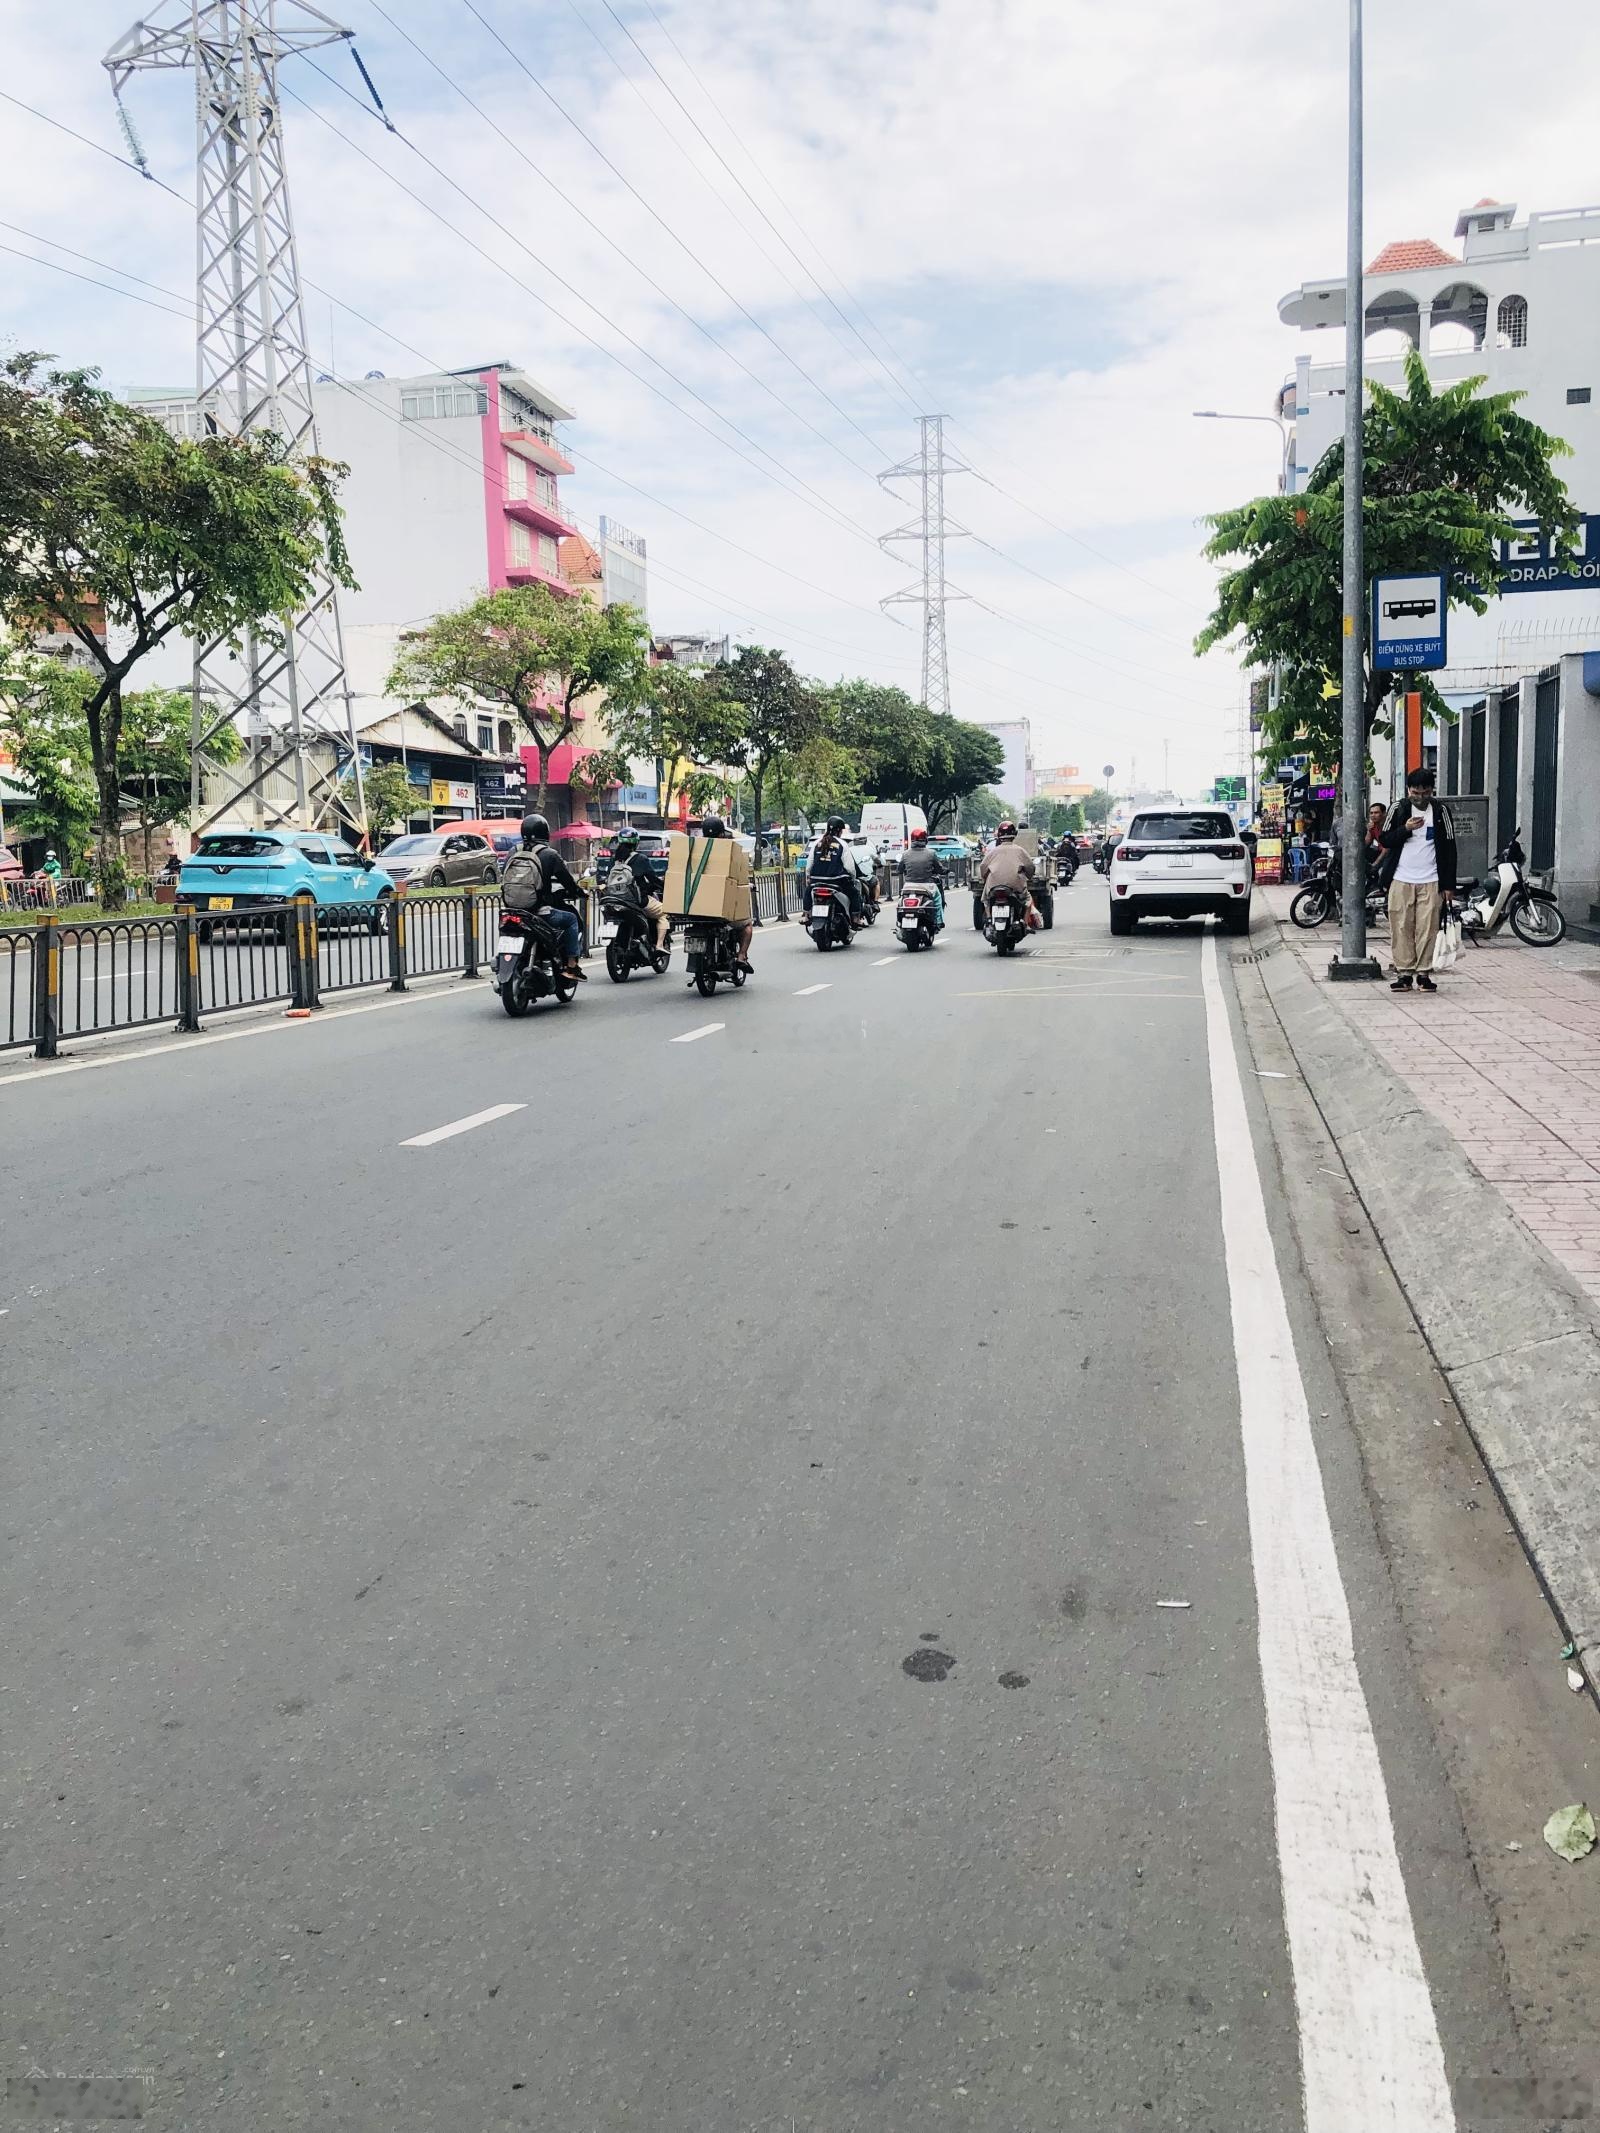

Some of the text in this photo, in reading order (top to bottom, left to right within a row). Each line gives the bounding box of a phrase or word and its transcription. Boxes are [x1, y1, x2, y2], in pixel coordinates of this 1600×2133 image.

[1491, 523, 1587, 561] EN
[1510, 566, 1559, 582] DRAP
[1414, 643, 1423, 652] XE
[1394, 655, 1425, 666] BUS STOP
[485, 780, 500, 788] 462
[456, 787, 469, 799] 462
